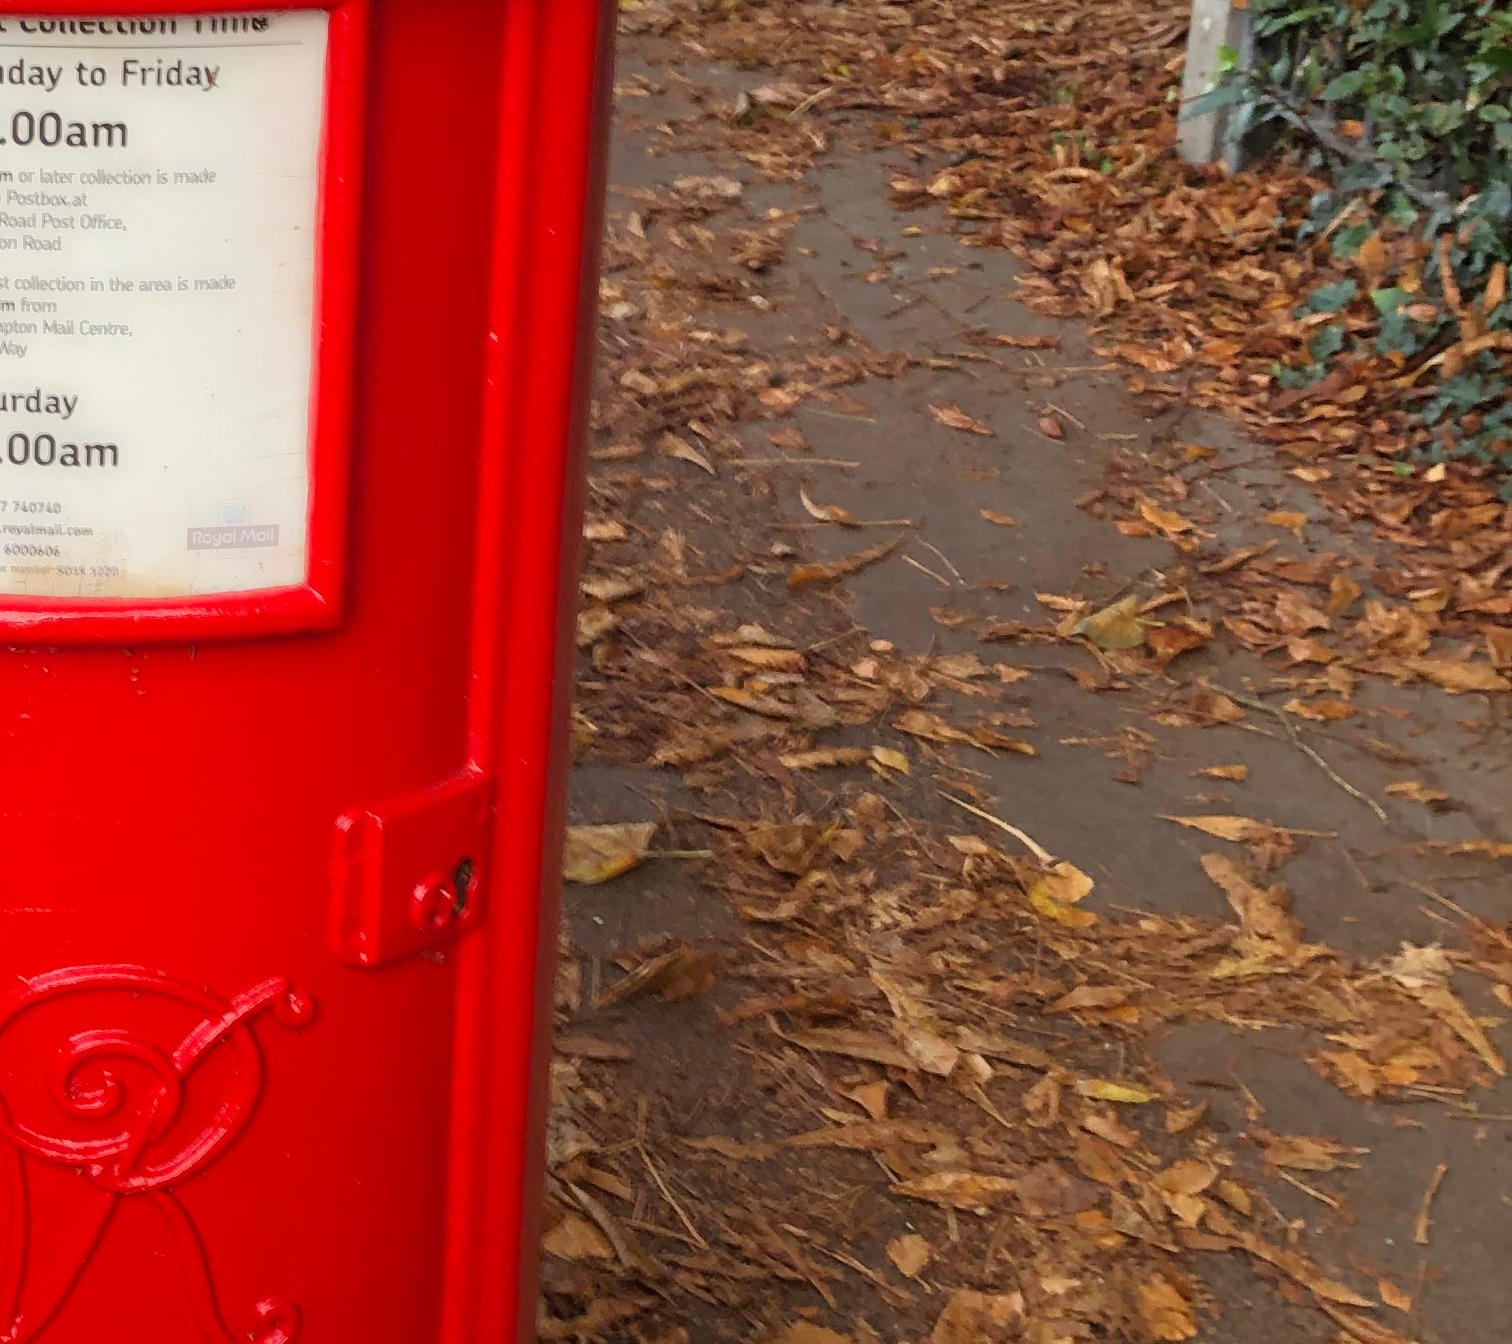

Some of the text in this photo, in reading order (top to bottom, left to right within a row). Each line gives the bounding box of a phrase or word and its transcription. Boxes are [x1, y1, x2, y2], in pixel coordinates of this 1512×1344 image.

[76, 62, 107, 87] to
[121, 58, 221, 92] Friday
[18, 171, 35, 183] or
[39, 168, 75, 184] later
[80, 168, 152, 185] collection
[156, 169, 169, 184] is
[173, 168, 217, 184] made
[6, 189, 67, 206] Postbox
[71, 193, 88, 207] at
[41, 213, 75, 229] Post
[80, 214, 127, 231] Office,
[22, 234, 63, 251] Road
[14, 275, 85, 292] collection
[90, 277, 105, 292] in
[109, 277, 134, 292] the
[138, 280, 173, 292] area
[177, 276, 189, 290] is
[193, 274, 237, 291] made
[20, 297, 58, 313] from
[42, 320, 75, 335] Mail
[79, 320, 133, 337] Centre,
[12, 500, 62, 514] 740740
[192, 526, 275, 547] Royal Mail
